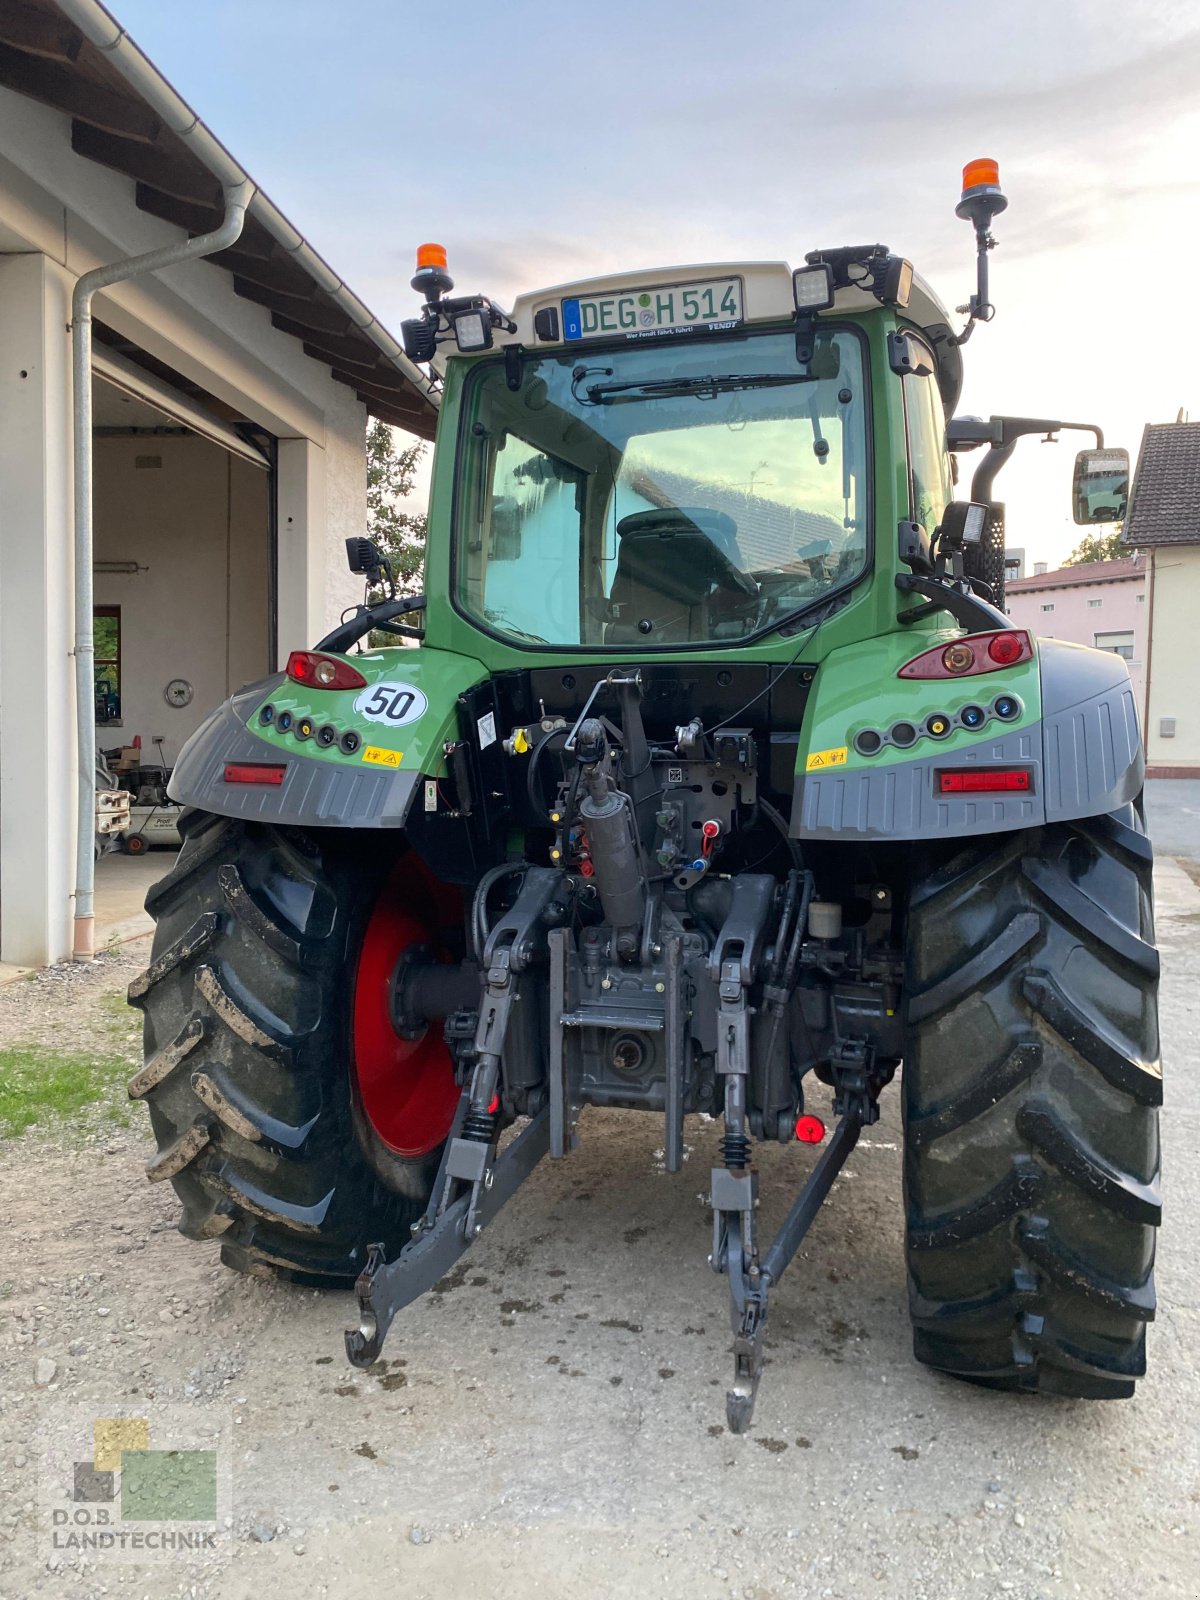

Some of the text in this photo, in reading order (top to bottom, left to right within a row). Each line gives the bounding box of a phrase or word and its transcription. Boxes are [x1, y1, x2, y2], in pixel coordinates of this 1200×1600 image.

[581, 285, 737, 333] DEG H 514
[570, 323, 576, 333] D
[364, 686, 415, 719] 50
